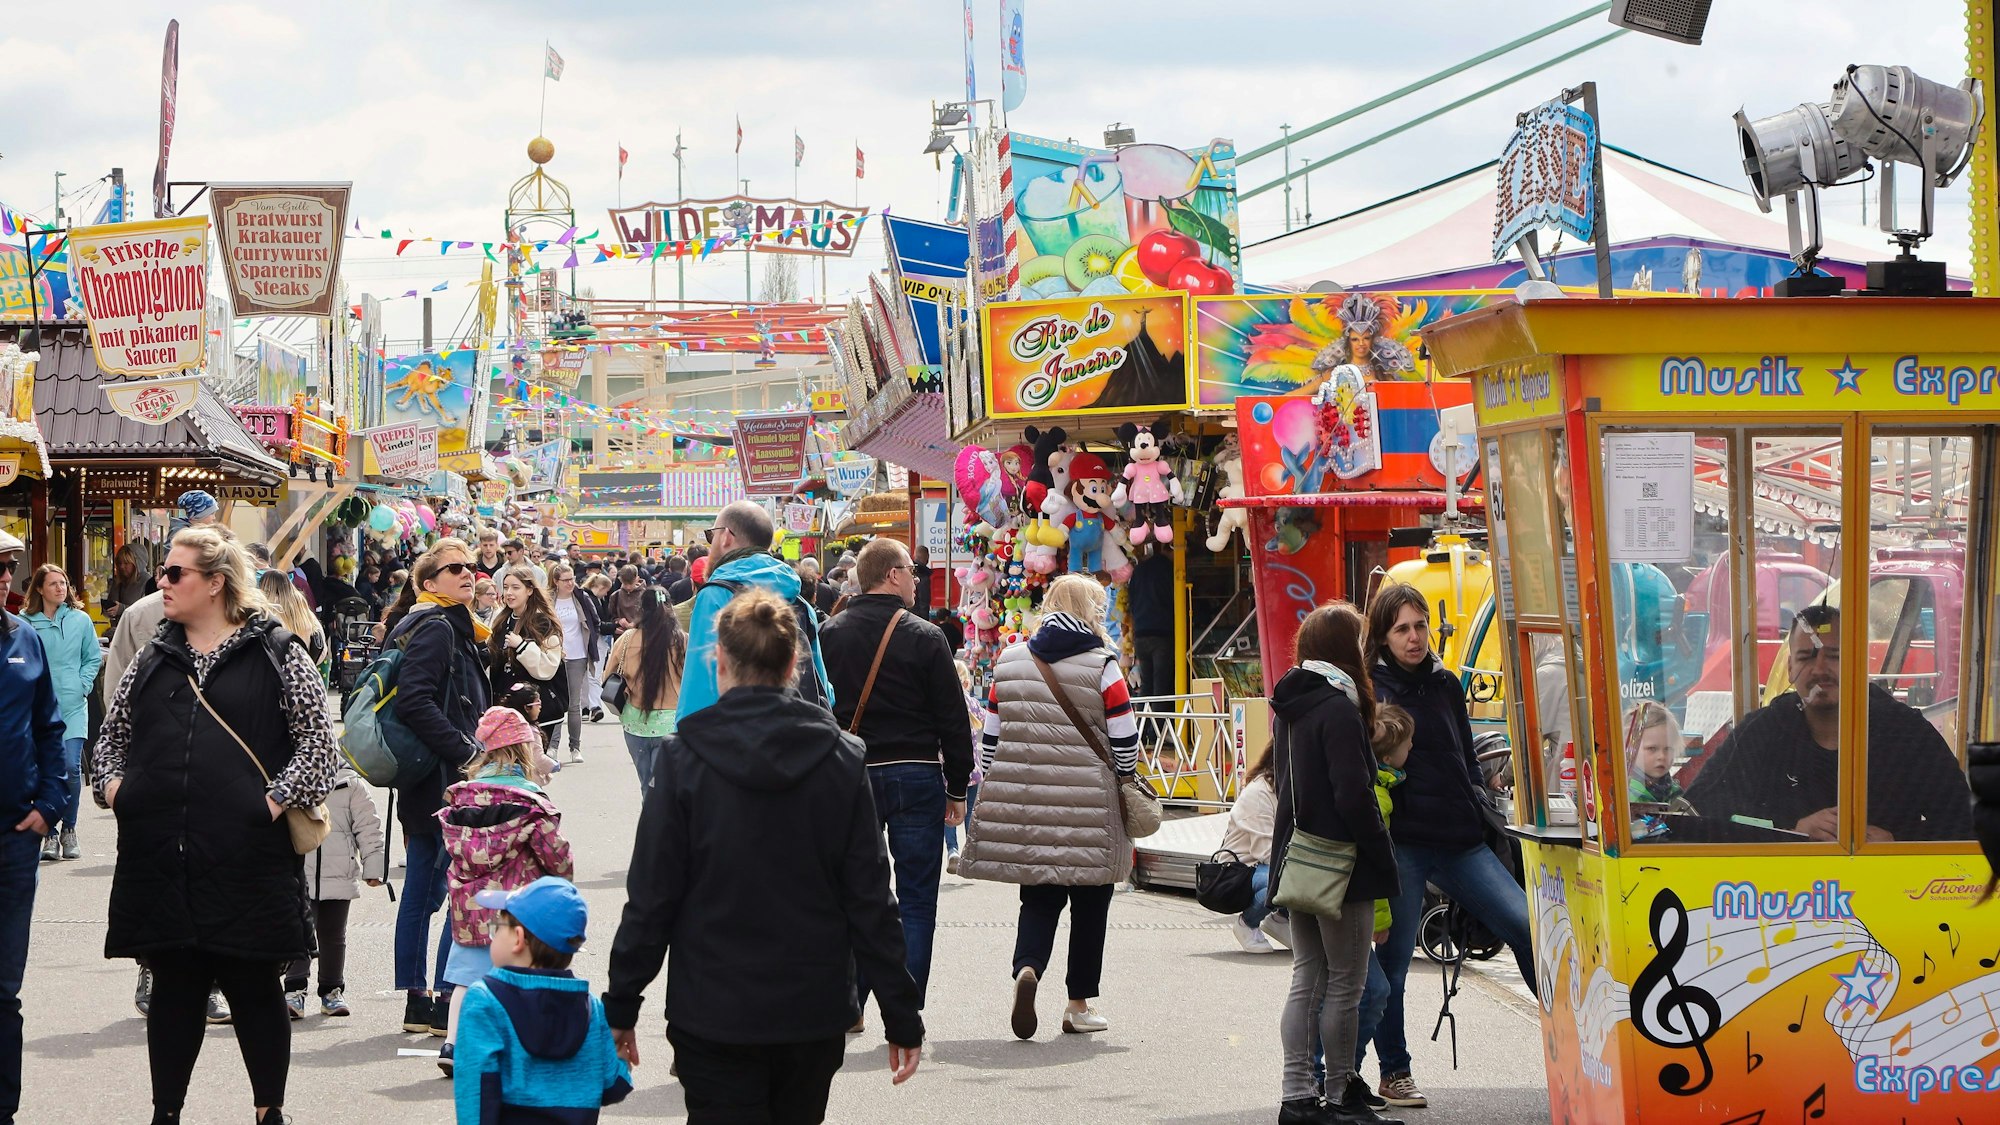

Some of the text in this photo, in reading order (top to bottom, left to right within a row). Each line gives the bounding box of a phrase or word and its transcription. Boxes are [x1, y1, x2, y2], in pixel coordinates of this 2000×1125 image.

[251, 201, 275, 211] Vom
[236, 212, 323, 227] Bratwurst
[618, 205, 856, 252] WILDE MAUS
[238, 229, 322, 244] Krakauer
[101, 239, 180, 266] Frische
[233, 246, 328, 263] Currywurst
[240, 263, 322, 279] Spareribs
[81, 260, 204, 323] Champignons
[254, 280, 310, 296] Steaks
[904, 280, 925, 294] VIP
[98, 323, 198, 349] mit pikanten
[1014, 306, 1111, 358] Rio de
[125, 347, 177, 367] Saucen
[1021, 350, 1123, 407] Janeiro
[1660, 355, 2000, 405] Musik Expr
[135, 393, 175, 413] VEGAN
[237, 414, 276, 436] TE
[743, 420, 804, 432] Holland Snack
[379, 439, 414, 453] kinder
[382, 460, 418, 474] nutella
[101, 478, 141, 489] Bratwurst
[1620, 672, 1655, 698] olizei
[1713, 880, 1856, 920] Musik
[1855, 1054, 2000, 1104] Expres
